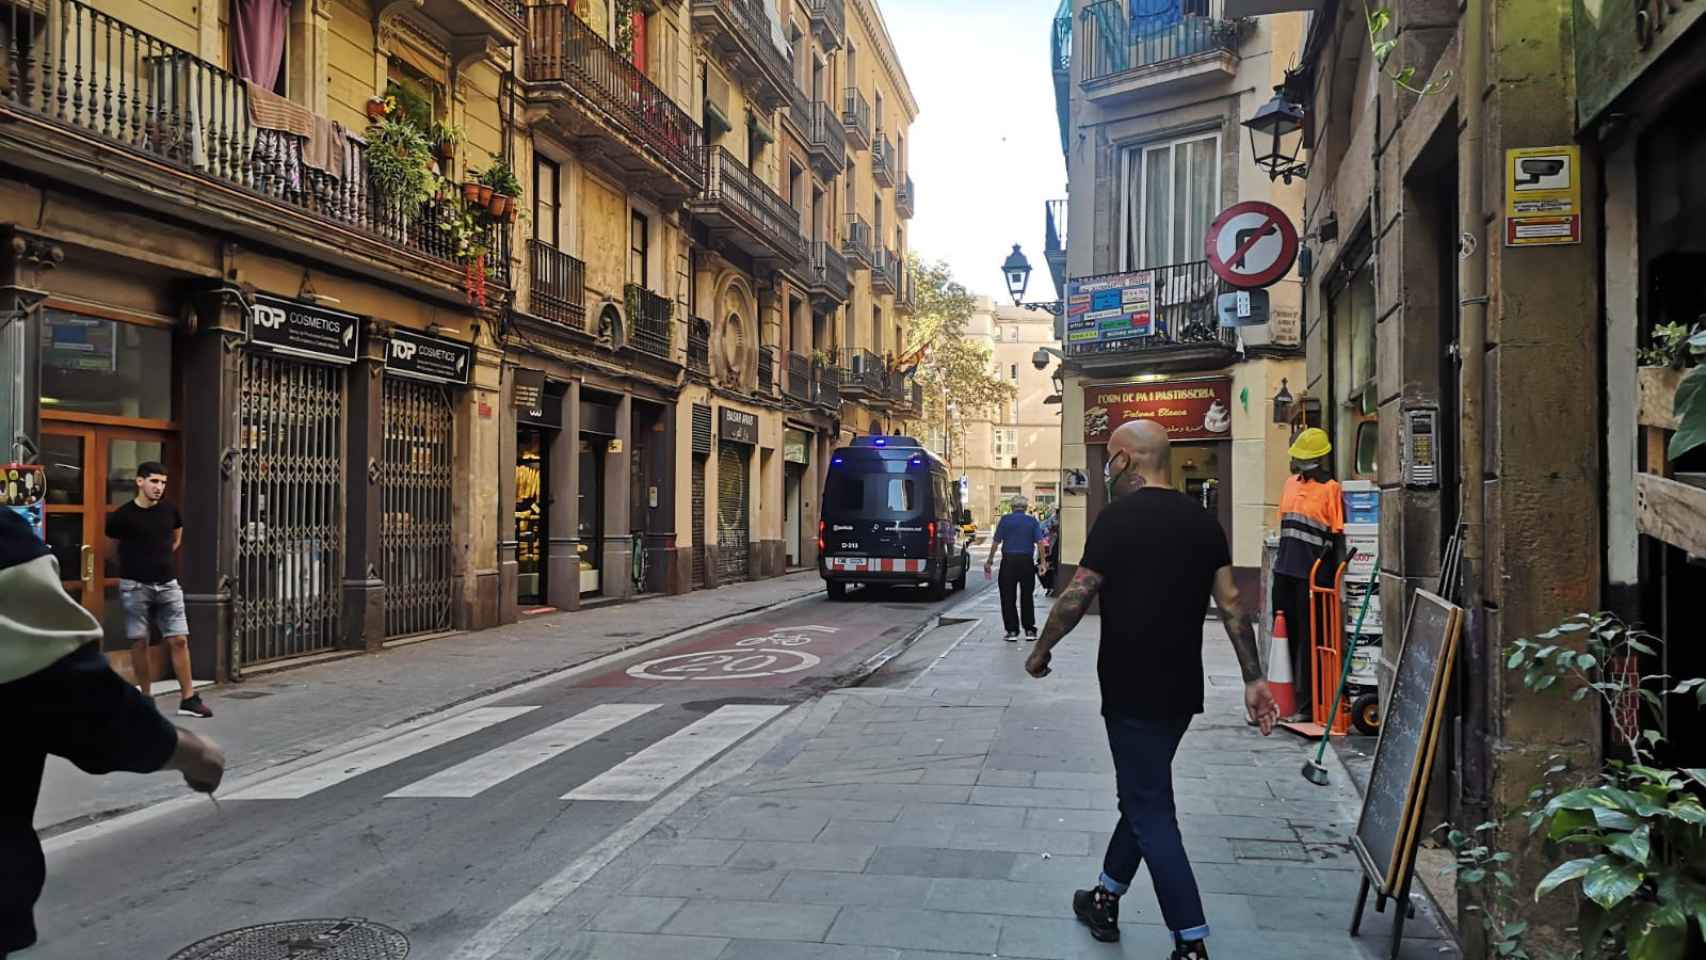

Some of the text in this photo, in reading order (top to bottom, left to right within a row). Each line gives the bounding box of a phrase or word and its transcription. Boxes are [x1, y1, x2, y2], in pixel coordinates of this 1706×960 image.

[251, 304, 340, 333] TOP COSMETICS
[391, 339, 455, 362] TOP COSMETICS
[1136, 391, 1148, 402] PA
[1155, 388, 1215, 401] PASTISSERIA
[1158, 407, 1187, 417] Blanca
